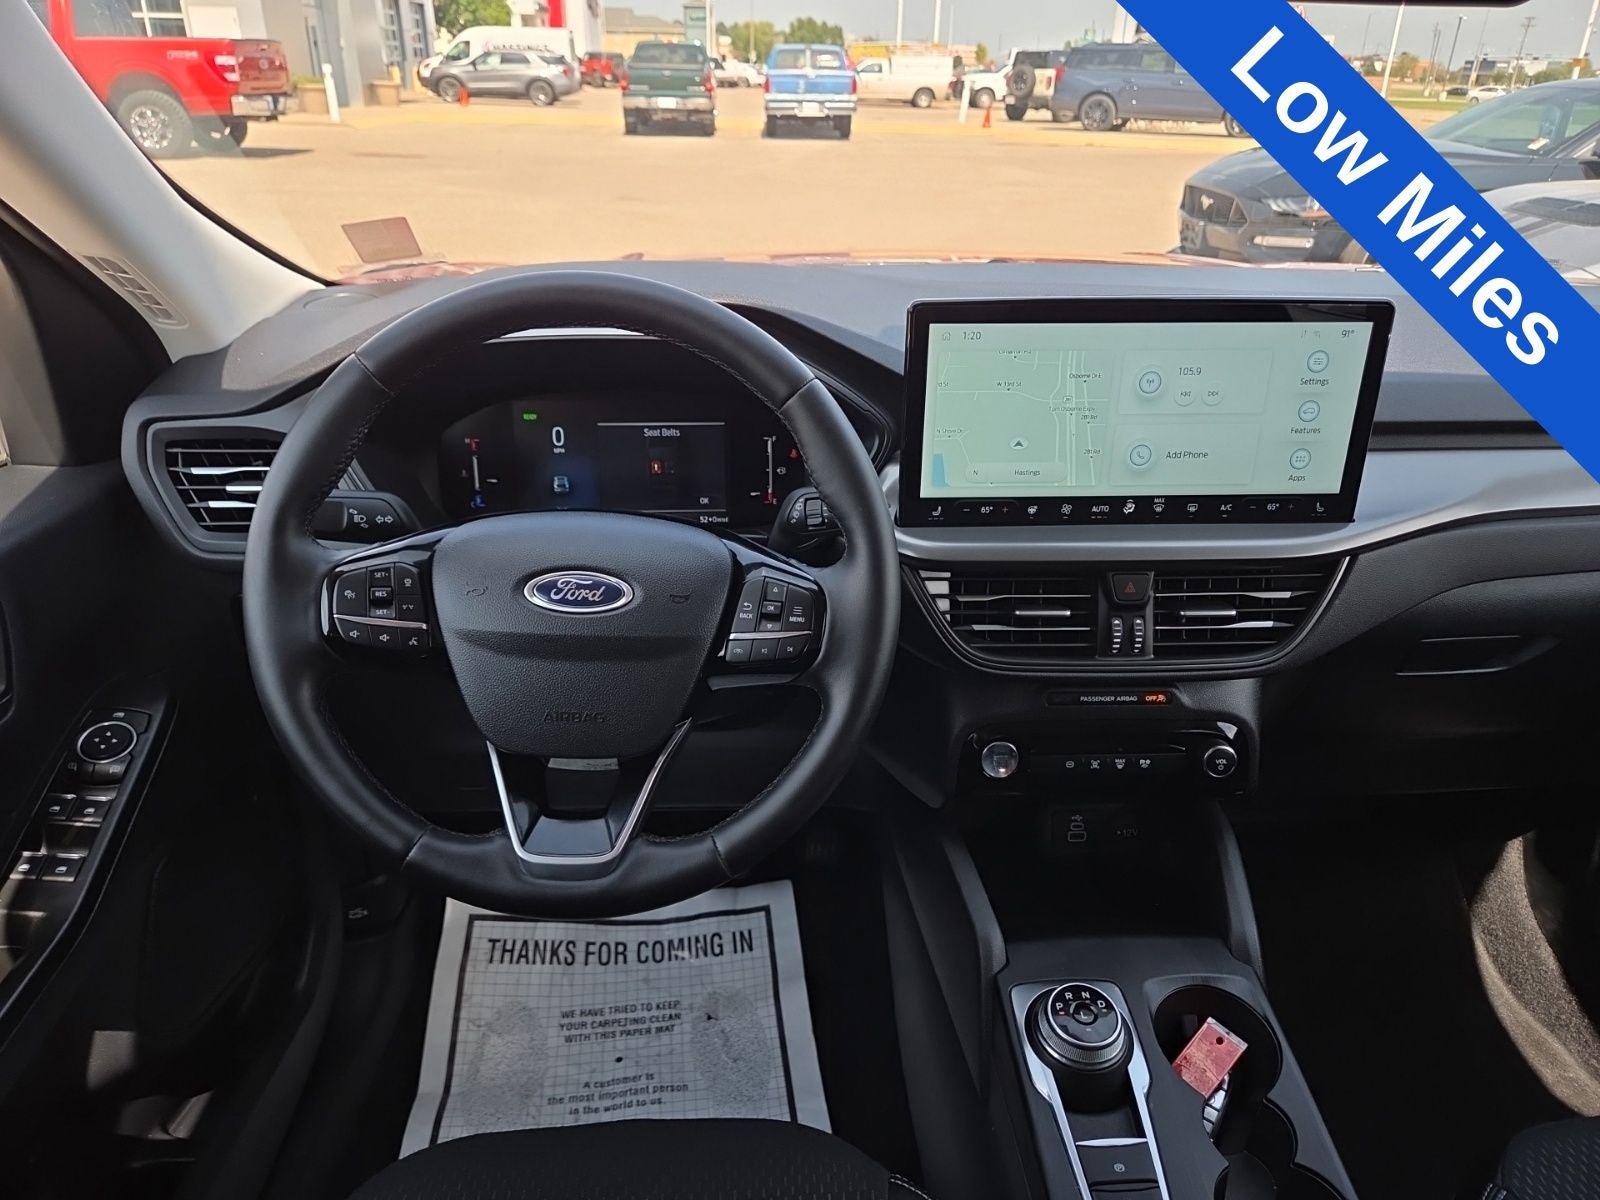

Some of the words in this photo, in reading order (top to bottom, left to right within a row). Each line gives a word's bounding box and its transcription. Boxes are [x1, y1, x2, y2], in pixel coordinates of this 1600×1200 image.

[962, 331, 982, 341] 1:20
[1178, 366, 1202, 376] 105.9
[1299, 377, 1330, 386] Settings
[643, 428, 660, 437] Seat
[661, 428, 681, 437] Belts
[1290, 426, 1321, 435] Features
[552, 426, 565, 447] 0
[1165, 451, 1181, 459] Add
[1182, 451, 1209, 459] Phone
[1014, 469, 1041, 478] Hastings
[1288, 474, 1306, 482] Apps
[1091, 505, 1109, 513] AUTO
[1220, 503, 1233, 511] A/C
[550, 577, 606, 602] Ford
[766, 604, 775, 612] OK
[1145, 694, 1157, 702] OFF
[543, 711, 606, 723] AIRBAG
[487, 938, 577, 966] THANKS
[584, 940, 629, 966] FOR
[636, 932, 724, 964] COMING
[731, 929, 755, 954] IN
[1065, 991, 1073, 1000] R
[1081, 991, 1091, 1000] N
[1055, 1002, 1064, 1011] P
[1097, 1000, 1106, 1008] D
[561, 1009, 576, 1019] WE
[580, 1006, 605, 1017] HAVE
[608, 1003, 637, 1014] TRIED
[640, 1001, 653, 1012] TO
[656, 999, 681, 1010] KEEP
[559, 1021, 588, 1032] YOUR
[591, 1015, 646, 1029] CARPETING
[649, 1011, 681, 1023] CLEAN
[564, 1033, 591, 1043] WITH
[594, 1029, 617, 1039] THIS
[620, 1026, 652, 1037] PAPER
[655, 1023, 676, 1033] MAT
[582, 1081, 591, 1089] A
[593, 1074, 643, 1089] customer
[645, 1072, 655, 1081] is
[547, 1096, 565, 1106] the
[568, 1092, 595, 1103] most
[598, 1085, 650, 1101] important
[652, 1083, 689, 1095] person
[568, 1106, 579, 1116] in
[583, 1103, 600, 1114] the
[603, 1099, 634, 1113] world
[636, 1098, 647, 1107] to
